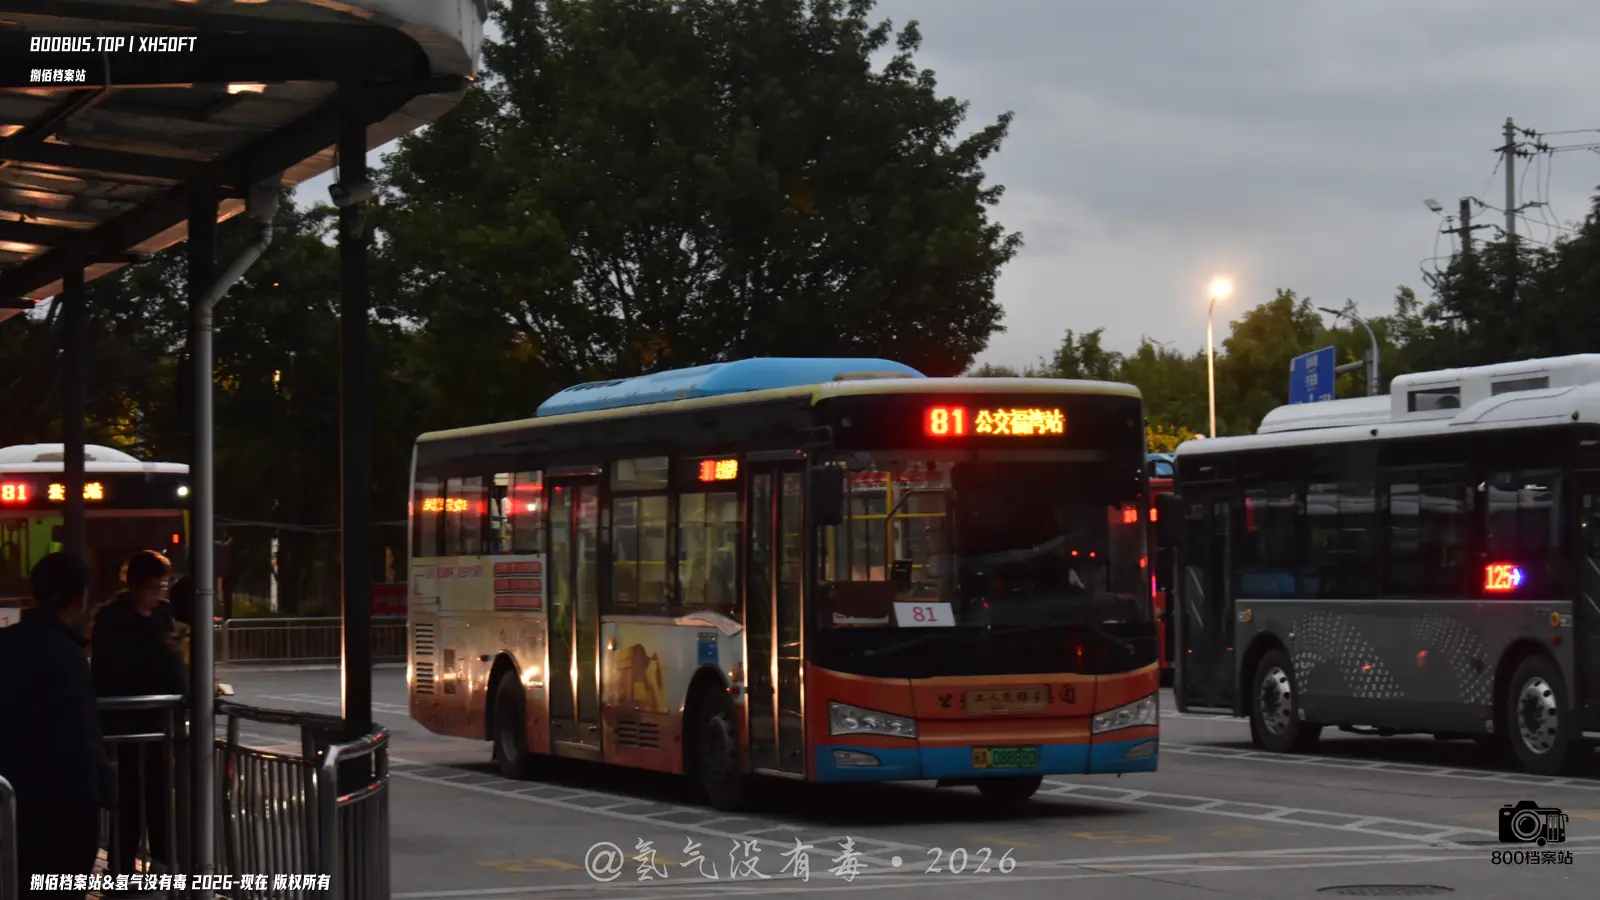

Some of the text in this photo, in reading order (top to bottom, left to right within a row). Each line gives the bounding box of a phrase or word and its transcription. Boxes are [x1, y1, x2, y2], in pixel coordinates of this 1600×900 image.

[930, 408, 963, 435] 81
[1, 483, 27, 501] 81
[1484, 564, 1512, 589] 125
[912, 606, 938, 622] 81
